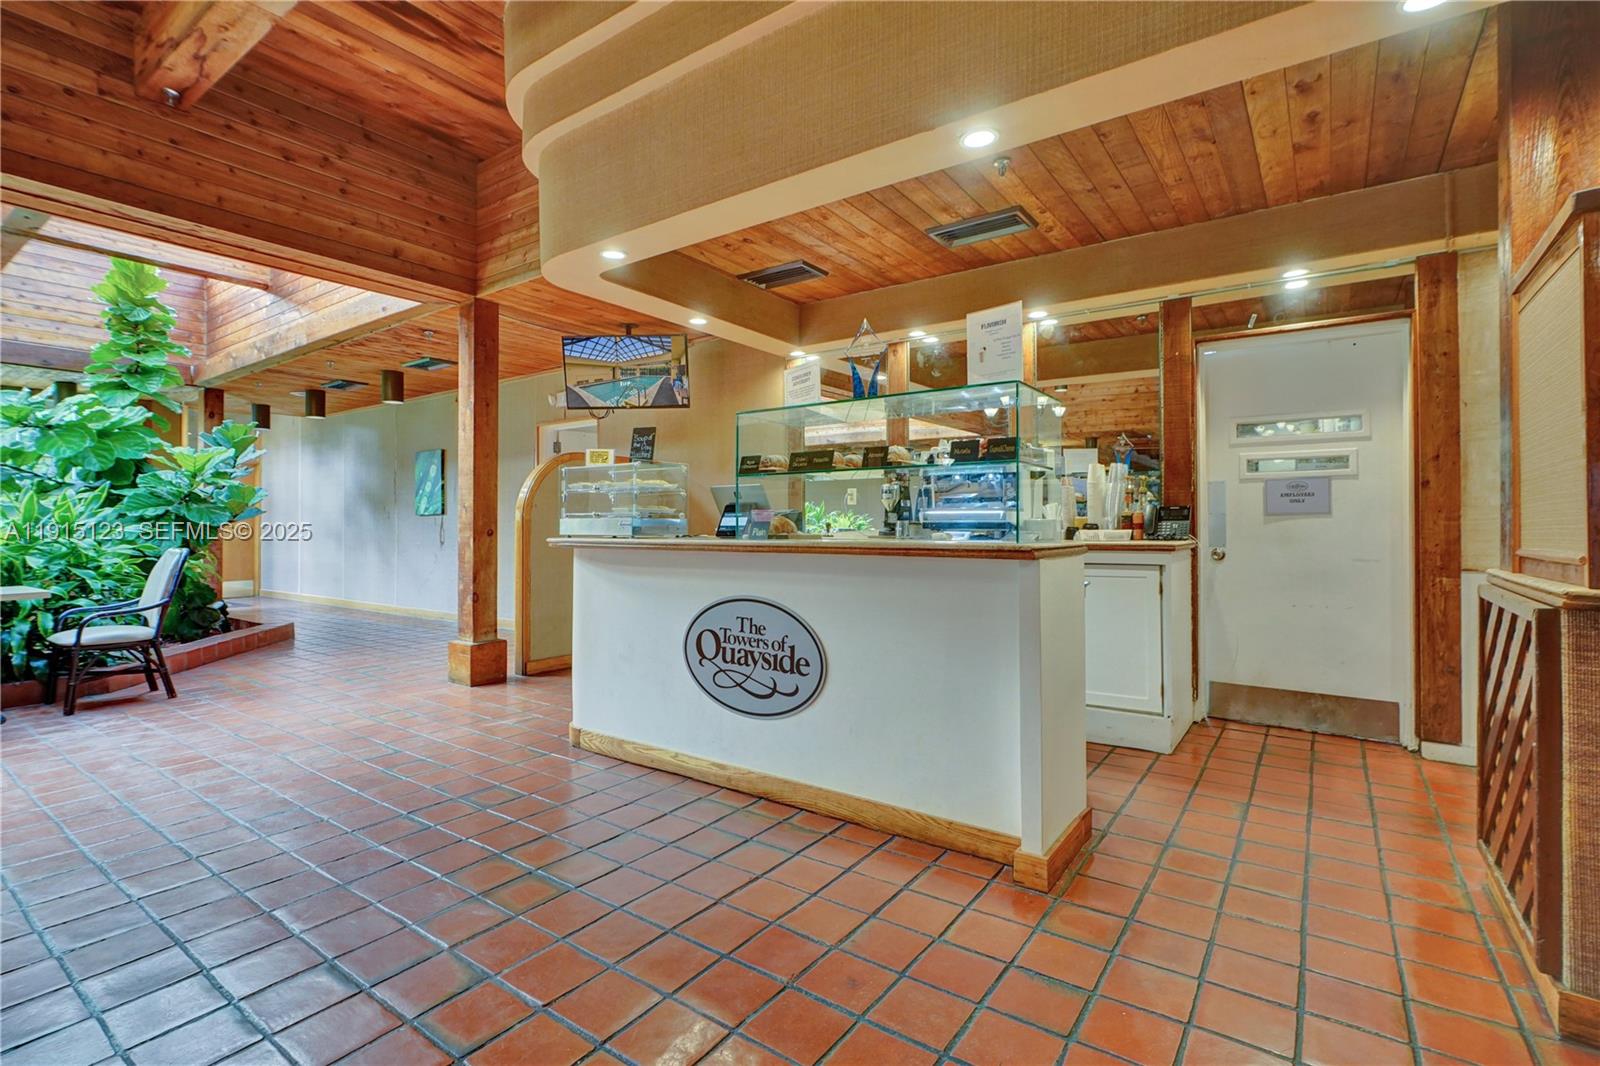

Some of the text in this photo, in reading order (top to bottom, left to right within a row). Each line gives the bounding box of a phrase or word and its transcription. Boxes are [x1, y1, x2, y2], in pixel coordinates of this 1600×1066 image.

[736, 616, 767, 636] The
[719, 627, 789, 652] Towers of
[695, 628, 811, 692] Quayside
